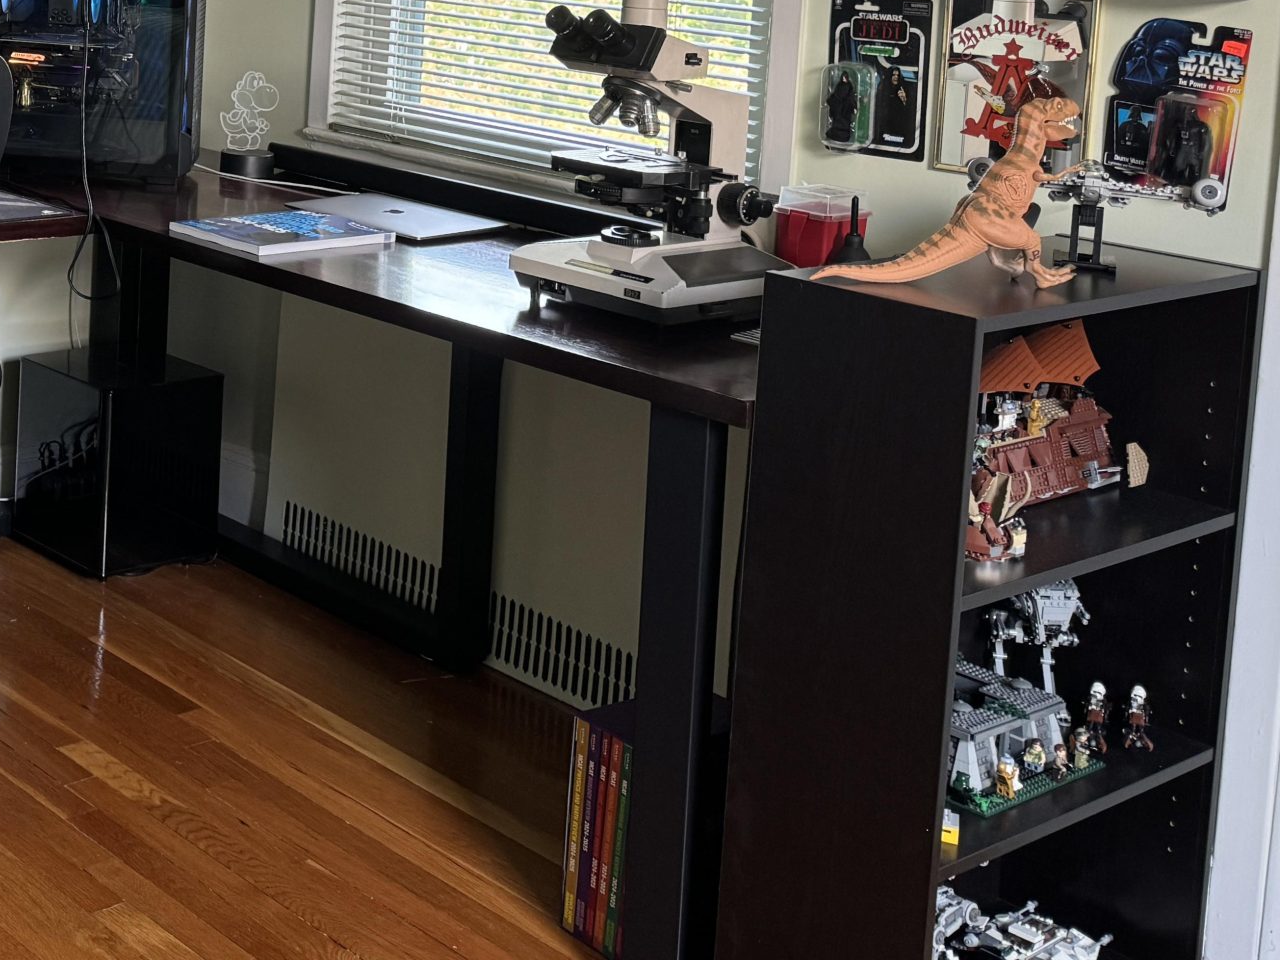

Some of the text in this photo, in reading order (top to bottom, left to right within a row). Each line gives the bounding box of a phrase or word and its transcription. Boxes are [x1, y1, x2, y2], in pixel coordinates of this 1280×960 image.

[858, 12, 903, 21] STAR WARS
[858, 22, 900, 40] JEDI
[951, 14, 1082, 60] Budweiser
[1178, 49, 1244, 71] STAR
[1178, 60, 1244, 83] WARS
